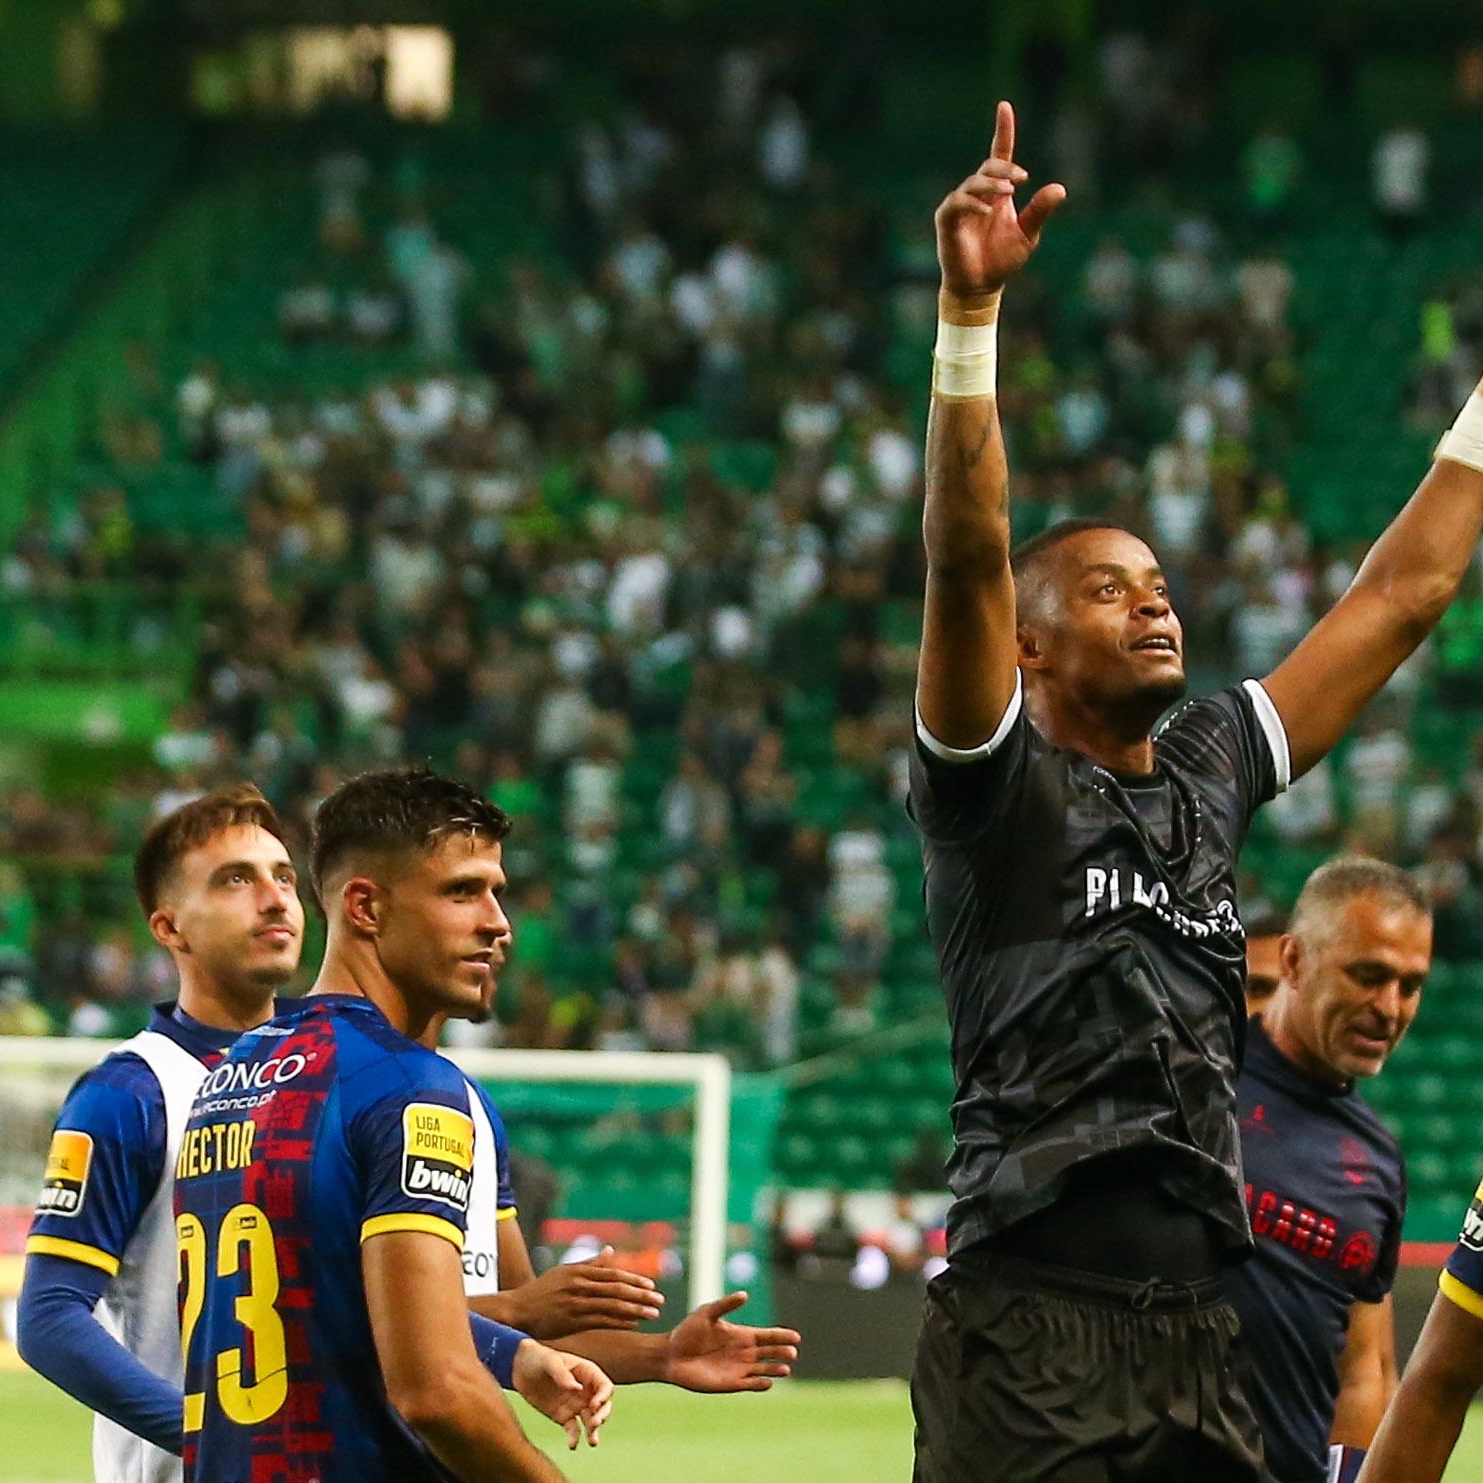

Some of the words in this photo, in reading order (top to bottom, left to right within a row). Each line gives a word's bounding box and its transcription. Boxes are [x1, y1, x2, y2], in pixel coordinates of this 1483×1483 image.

[415, 1115, 441, 1132] LIGA
[176, 1120, 257, 1180] HECTOR
[415, 1132, 466, 1158] PORTUGAL
[408, 1161, 468, 1203] bwin
[175, 1203, 289, 1433] 23
